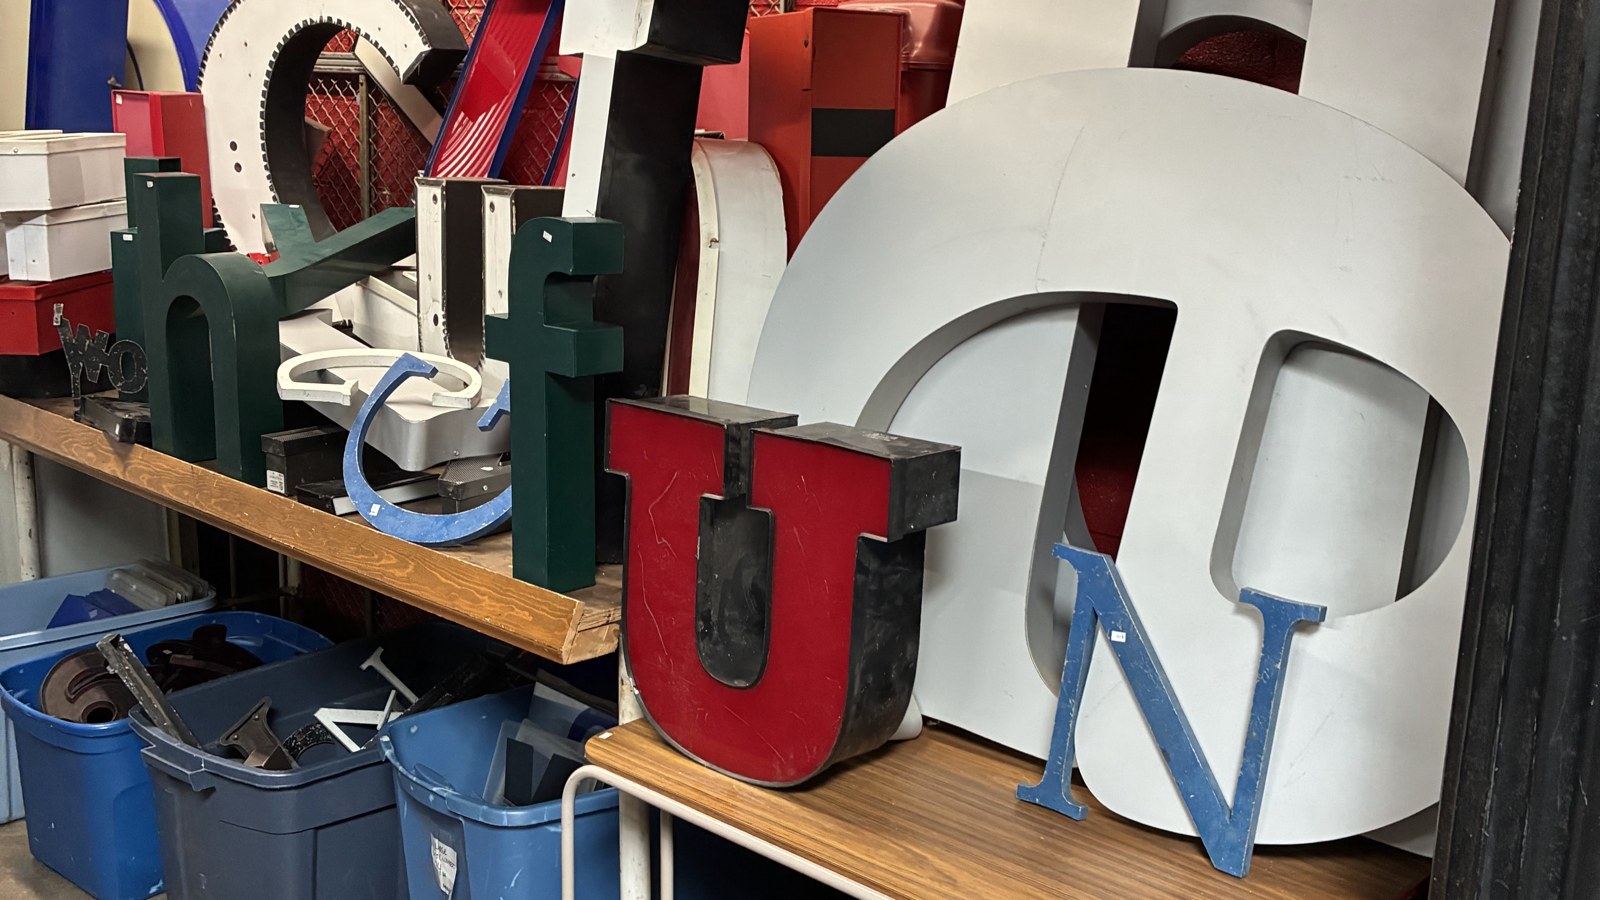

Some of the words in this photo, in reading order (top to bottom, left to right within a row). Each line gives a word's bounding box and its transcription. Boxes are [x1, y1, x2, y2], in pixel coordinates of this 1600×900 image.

[134, 172, 282, 490] h
[485, 216, 622, 594] f
[604, 396, 961, 789] U
[1015, 542, 1327, 878] N
